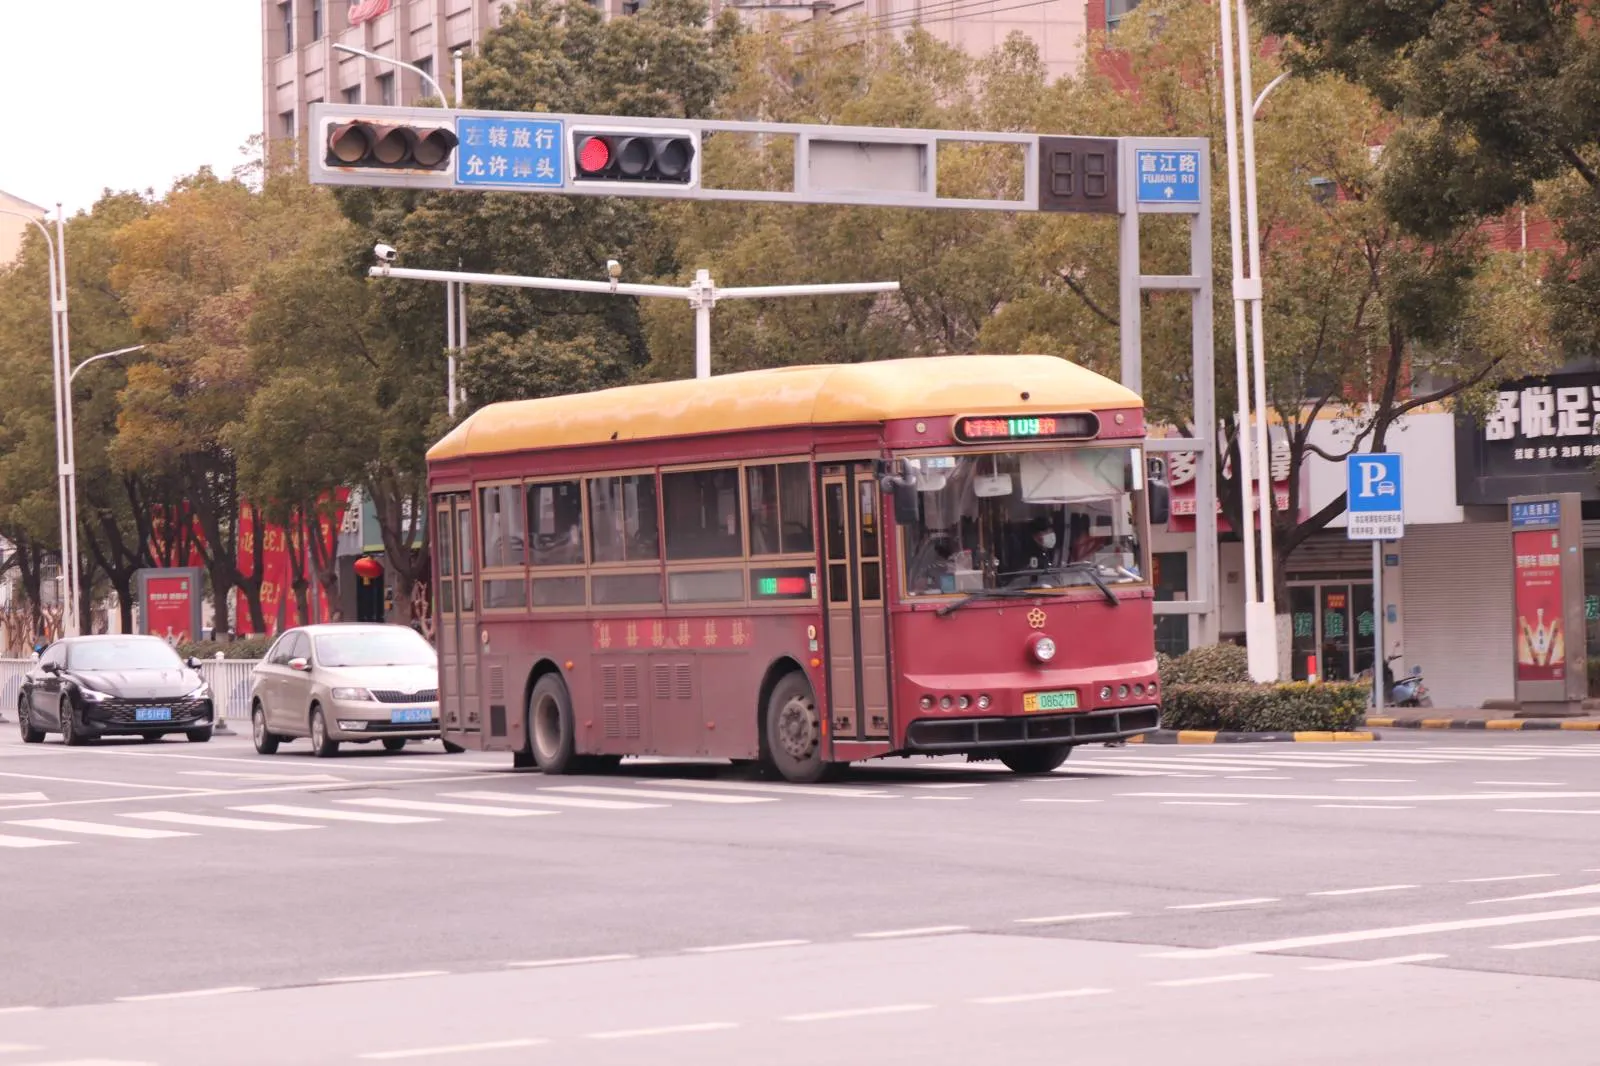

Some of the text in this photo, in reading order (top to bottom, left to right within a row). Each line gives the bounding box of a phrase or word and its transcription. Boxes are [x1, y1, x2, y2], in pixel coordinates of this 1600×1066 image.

[466, 126, 555, 150] 左转放行
[1140, 153, 1196, 172] 富江路
[1008, 417, 1040, 436] 109
[1358, 461, 1388, 498] P
